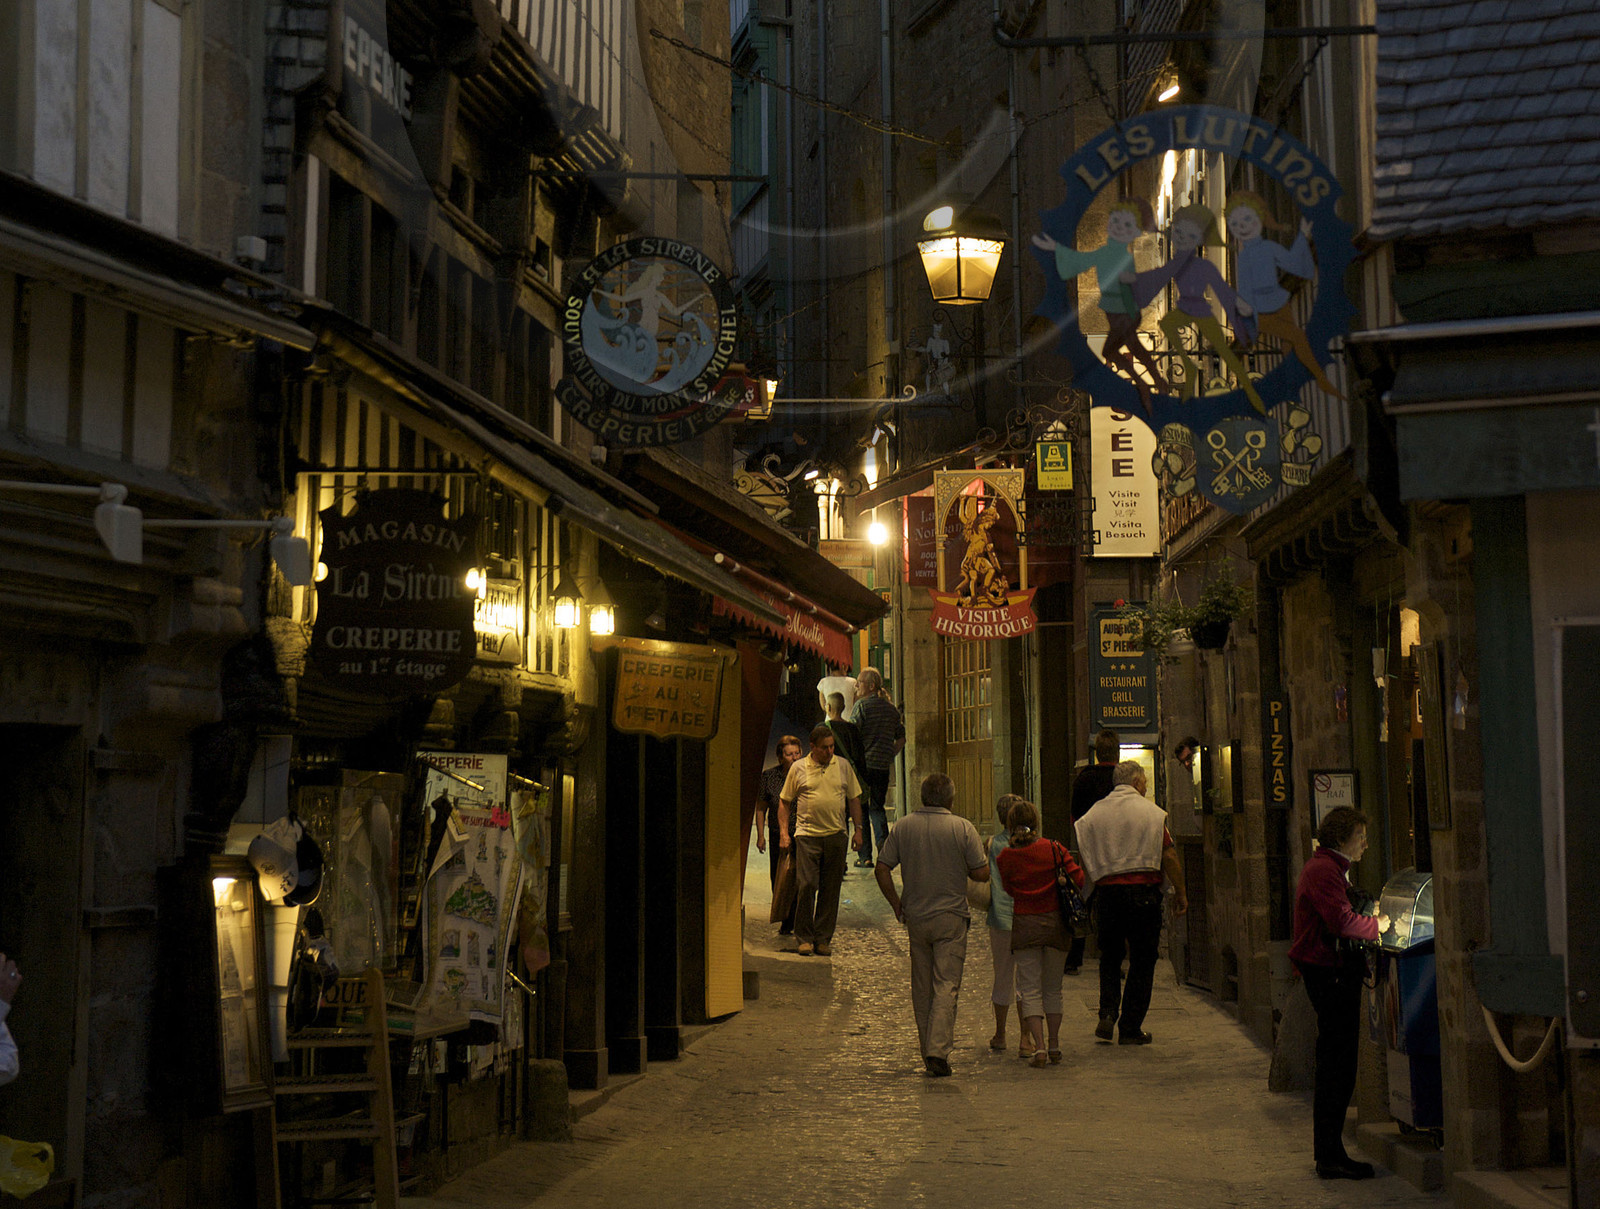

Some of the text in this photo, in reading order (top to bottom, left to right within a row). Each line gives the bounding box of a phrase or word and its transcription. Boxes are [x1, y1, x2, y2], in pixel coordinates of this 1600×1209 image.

[1074, 115, 1332, 207] LES LUTINS
[601, 244, 632, 268] LA
[564, 295, 610, 398] SOUVENIRS
[612, 393, 637, 412] DU
[709, 303, 738, 379] MICHEL
[1109, 520, 1142, 528] Visita
[336, 520, 467, 553] MAGASIN
[331, 565, 370, 599] La
[957, 607, 1012, 623] VISITE
[935, 615, 1033, 638] HISTORIQUE
[325, 625, 462, 652] CREPERIE
[339, 661, 362, 674] au
[395, 658, 447, 680] étage
[624, 660, 714, 682] CREPERIE
[1100, 676, 1147, 687] RESTAURANT
[655, 686, 679, 701] AU
[1112, 691, 1134, 703] GRILL
[643, 706, 706, 727] ETAGE
[1102, 705, 1145, 718] BRASSERIE
[1269, 700, 1287, 803] PIZZAS
